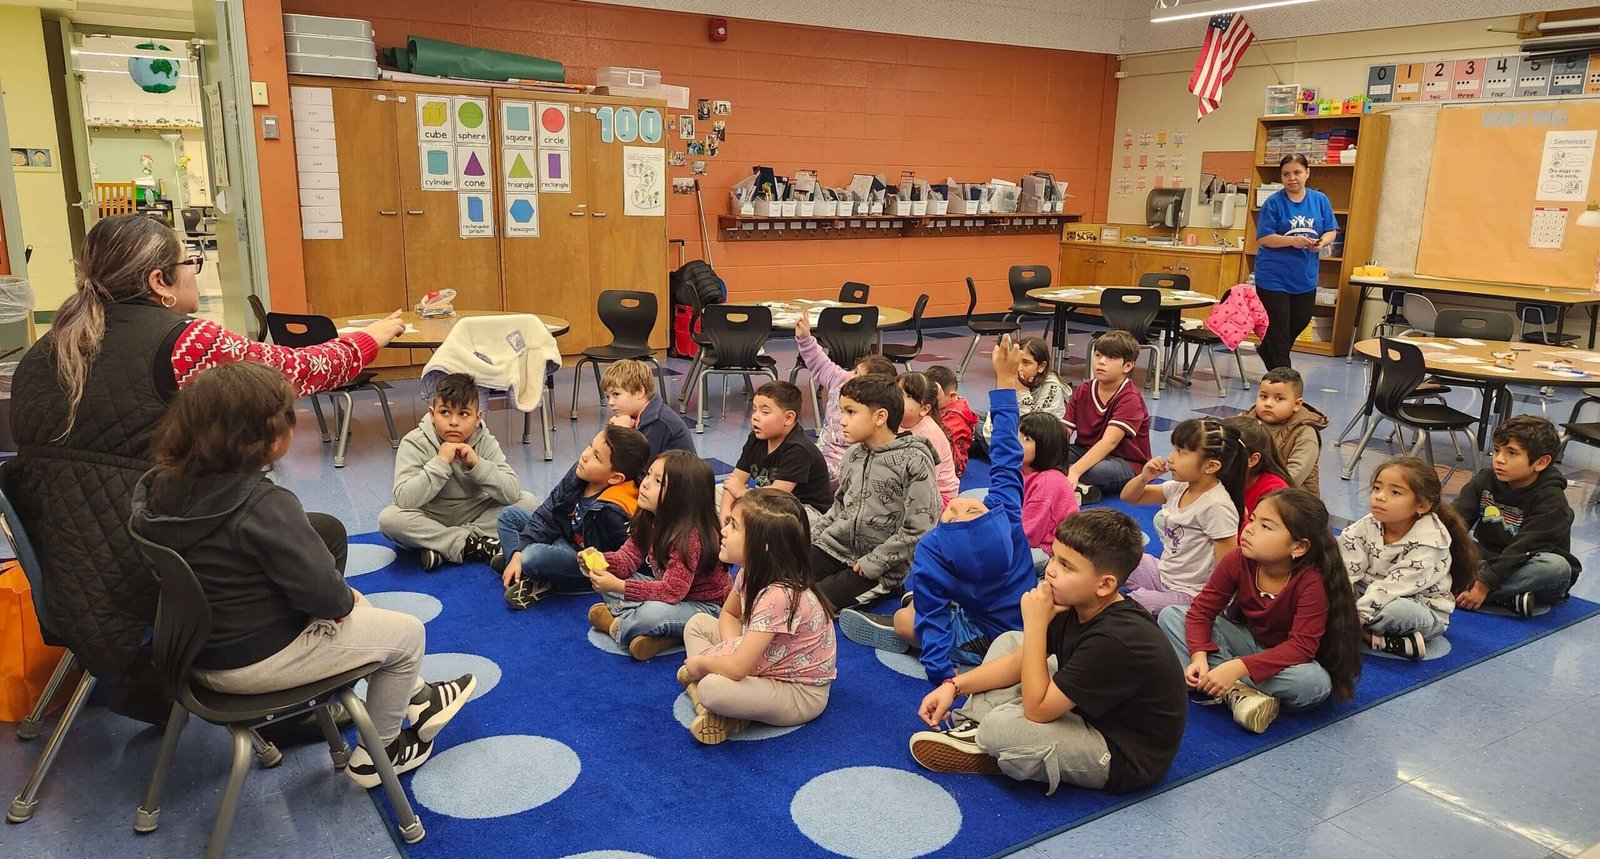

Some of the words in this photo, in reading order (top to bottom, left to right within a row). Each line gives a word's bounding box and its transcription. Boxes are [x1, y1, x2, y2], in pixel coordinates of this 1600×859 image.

[1408, 65, 1412, 78] 1
[1434, 63, 1444, 77] 2
[1465, 60, 1475, 75] 3
[1496, 58, 1507, 73] 4
[1530, 60, 1541, 71] 5
[1378, 67, 1387, 80] 0
[596, 106, 662, 144] 100
[425, 130, 447, 139] cube
[458, 132, 486, 140] sphere
